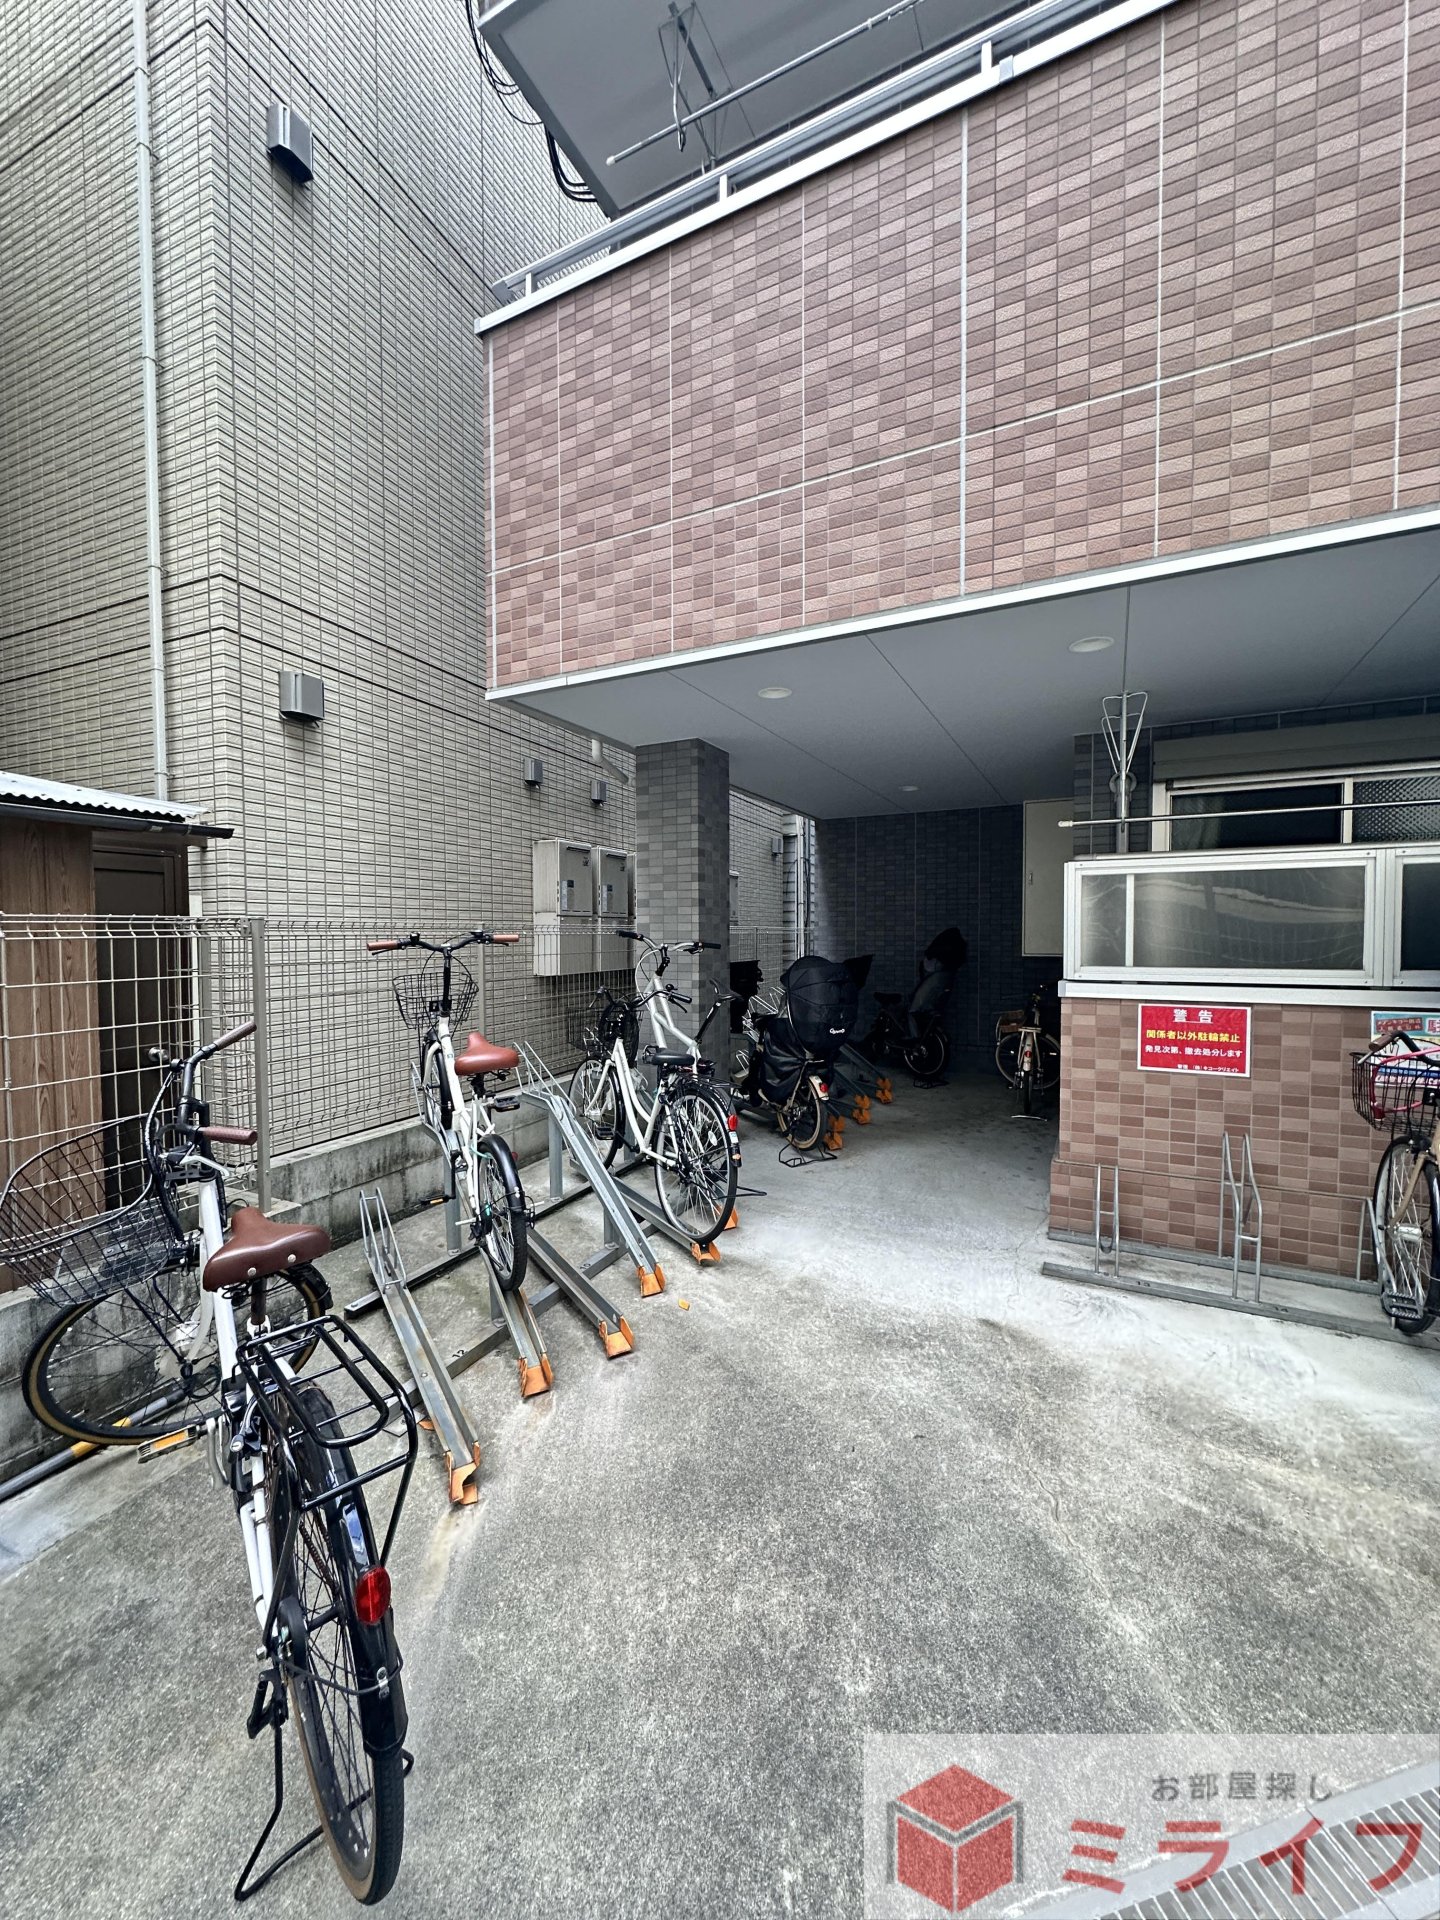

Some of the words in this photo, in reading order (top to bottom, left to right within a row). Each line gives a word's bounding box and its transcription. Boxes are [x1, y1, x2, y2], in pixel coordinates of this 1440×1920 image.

[1173, 1009, 1213, 1022] 警告
[1146, 1029, 1240, 1043] 関係者以外駐輪禁止
[1145, 1045, 1243, 1058] 発見次第、撤去処分します
